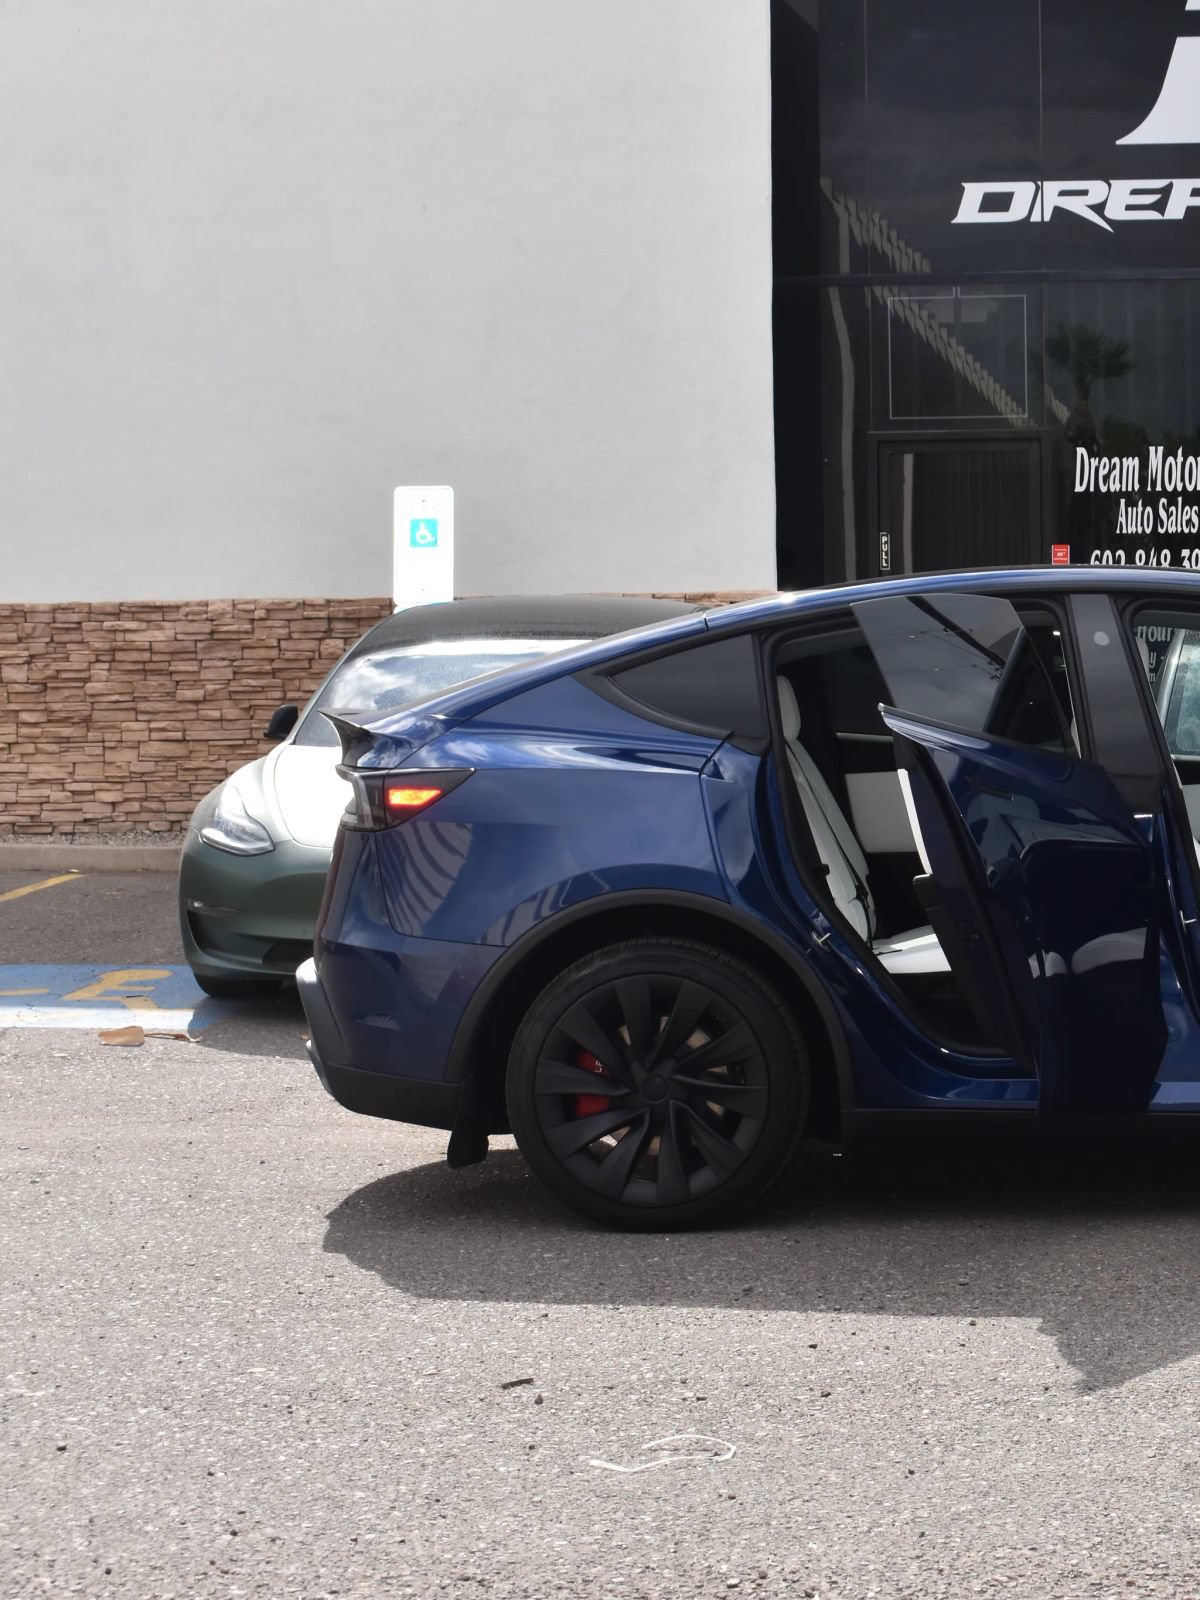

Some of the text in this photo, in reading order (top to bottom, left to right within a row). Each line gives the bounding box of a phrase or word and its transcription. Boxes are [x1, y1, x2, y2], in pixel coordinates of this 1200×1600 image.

[1074, 446, 1140, 492] Dream
[1116, 496, 1199, 534] Auto Sales
